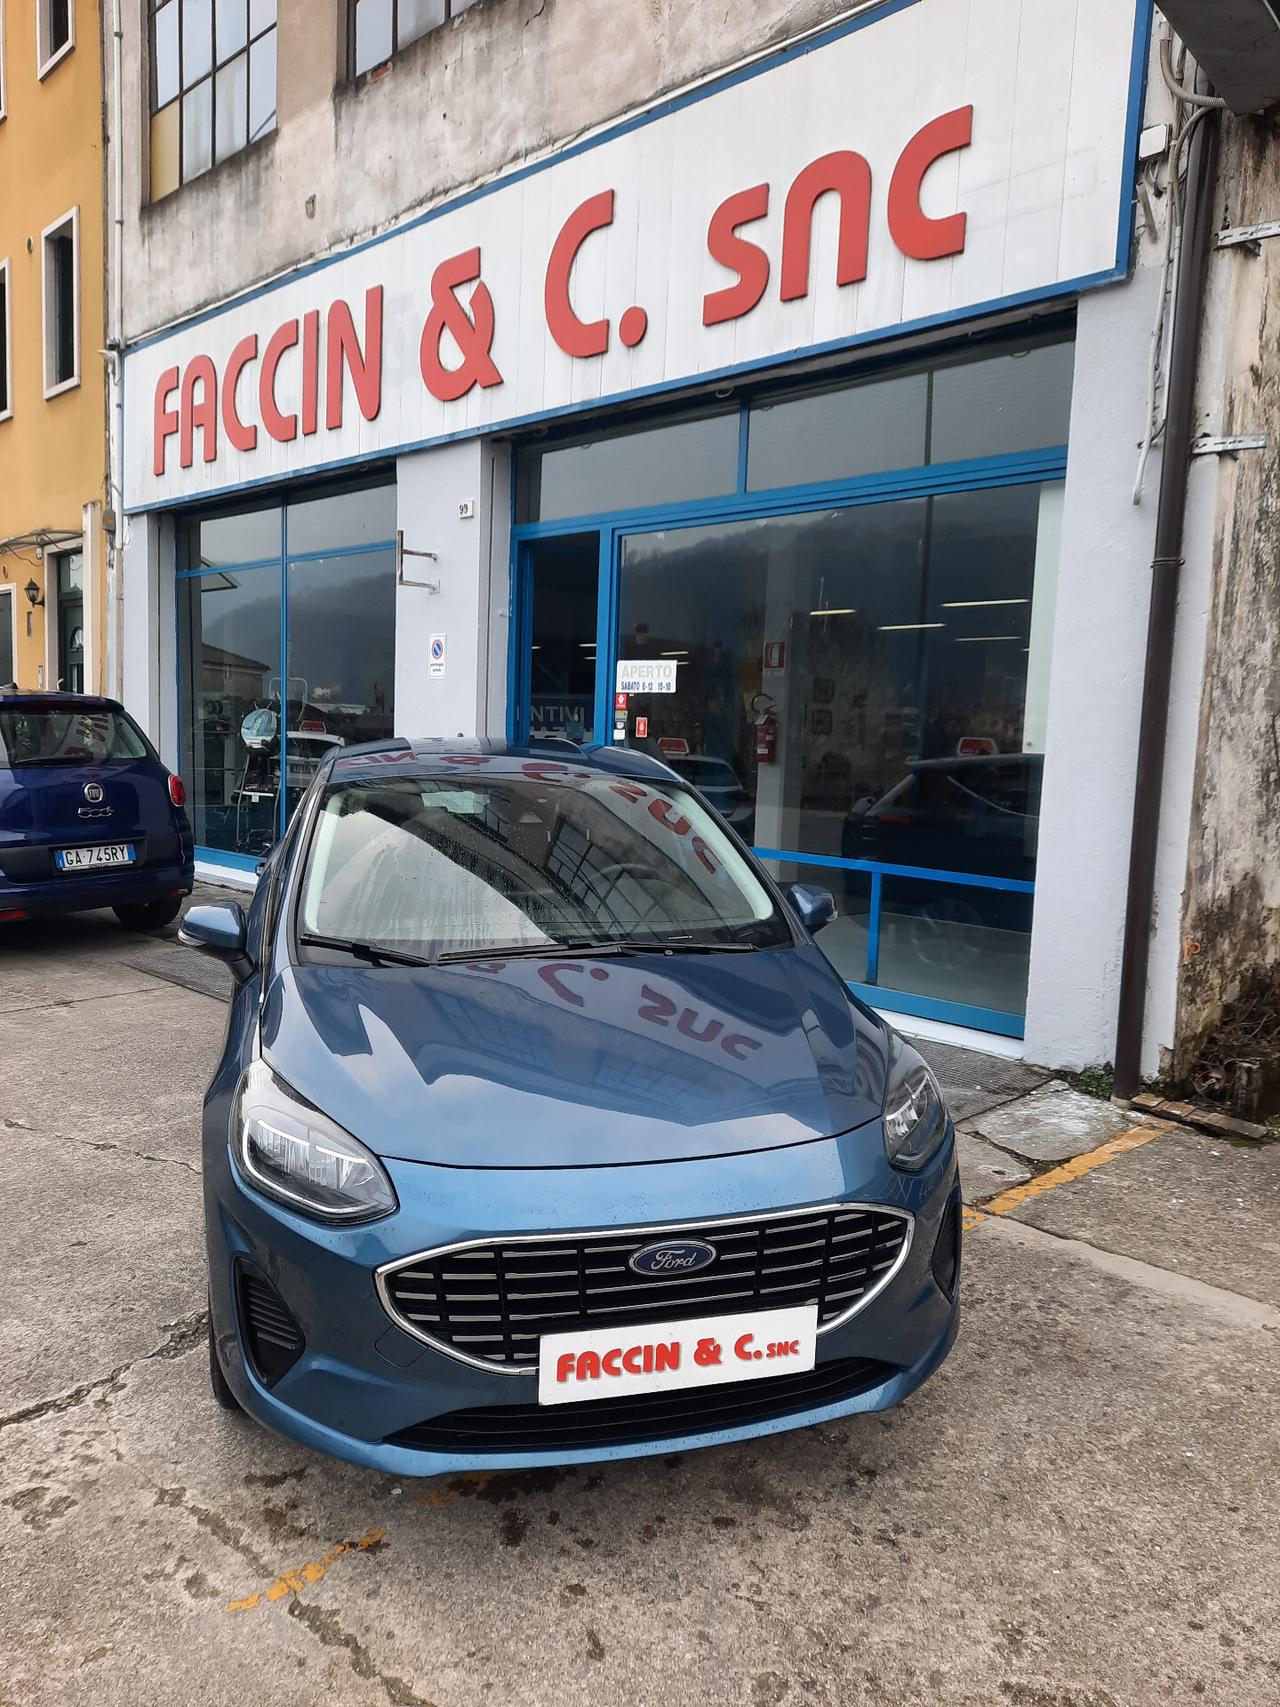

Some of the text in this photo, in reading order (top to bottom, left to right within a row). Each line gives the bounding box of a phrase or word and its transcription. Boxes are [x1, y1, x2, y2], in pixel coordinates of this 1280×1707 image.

[153, 285, 383, 476] FACCIN
[420, 246, 503, 402] &
[544, 188, 648, 358] C.
[621, 664, 673, 679] APERTO
[621, 681, 640, 691] SABATO
[65, 845, 127, 866] GA 745RY
[650, 1249, 698, 1270] Ford
[556, 1341, 681, 1383] FACCIN
[693, 1337, 722, 1367] &
